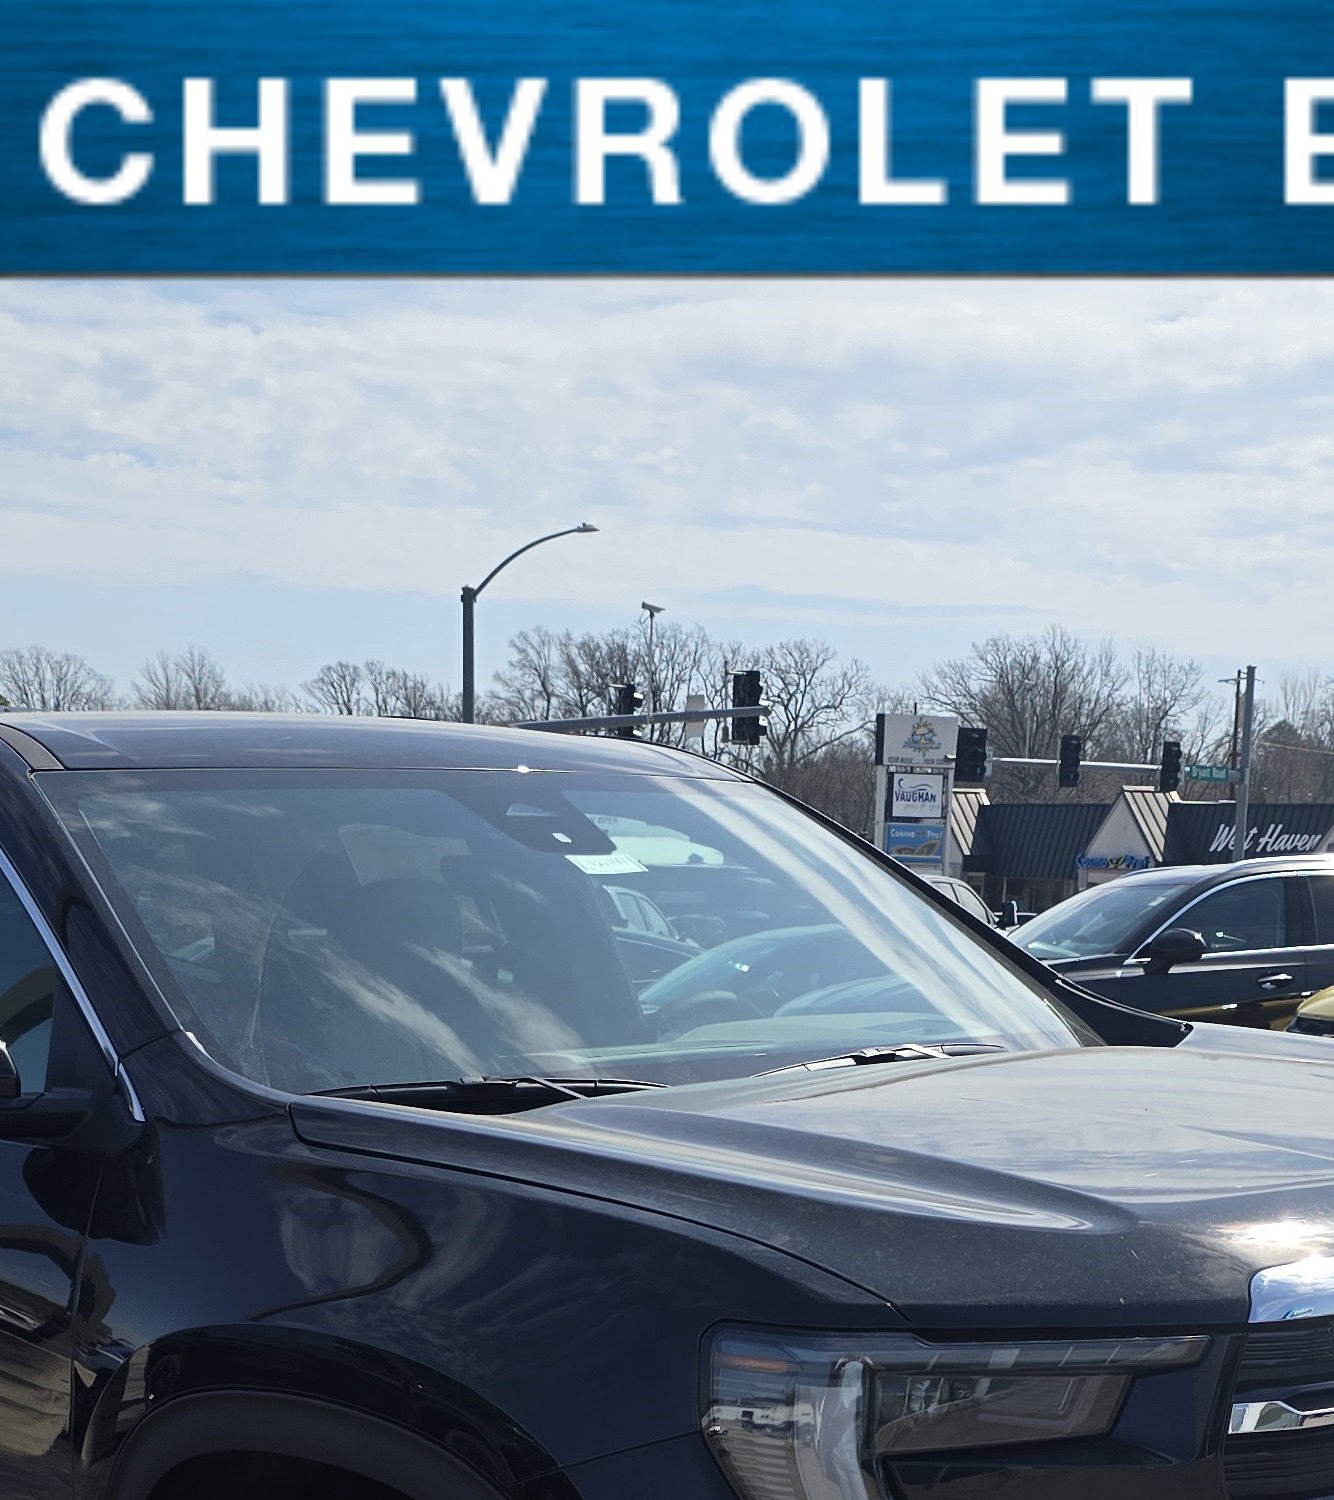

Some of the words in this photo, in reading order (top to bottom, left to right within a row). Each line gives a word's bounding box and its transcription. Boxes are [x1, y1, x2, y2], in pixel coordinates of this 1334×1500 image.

[894, 790, 937, 803] VAUGHAN
[1209, 823, 1259, 852] Wet
[1256, 823, 1322, 852] Haven
